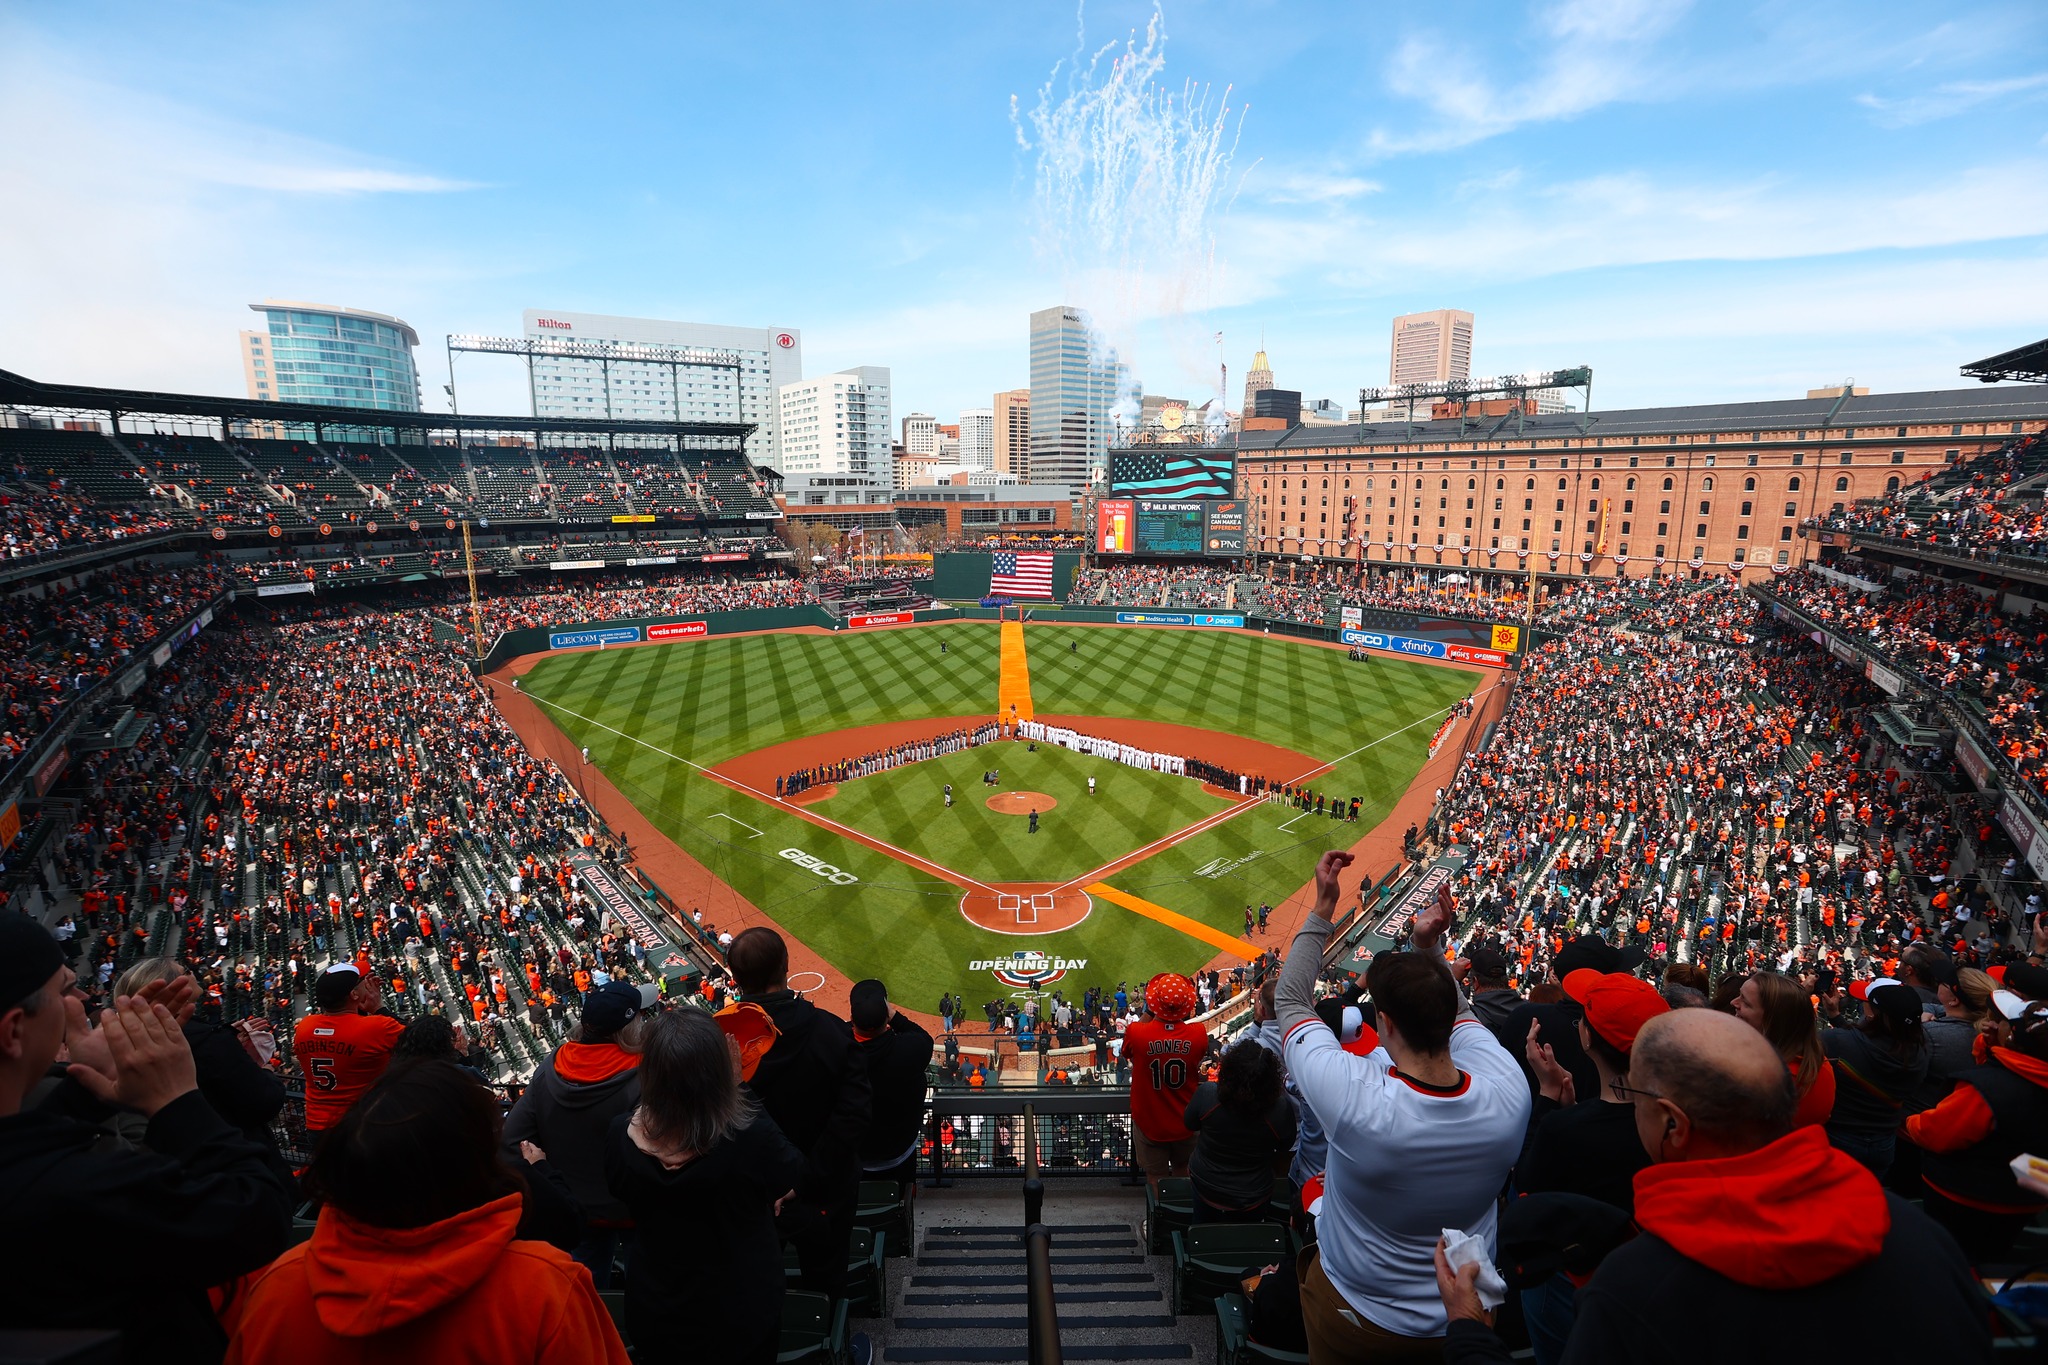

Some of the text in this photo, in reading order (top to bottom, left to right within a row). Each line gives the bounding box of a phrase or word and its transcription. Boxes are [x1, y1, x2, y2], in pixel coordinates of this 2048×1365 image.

[537, 319, 572, 330] Hilton
[1129, 433, 1153, 444] THE
[558, 516, 585, 524] GANZ
[215, 530, 225, 538] 20
[273, 527, 279, 535] 5
[1220, 541, 1241, 549] PNC
[1215, 617, 1234, 625] pepsi
[650, 625, 705, 636] weis markets
[1345, 632, 1383, 646] GEICO
[1401, 640, 1434, 654] xfinity
[2003, 797, 2030, 840] Point Breeze
[778, 848, 859, 885] GEICO
[1206, 850, 1265, 880] MedStar Health
[583, 866, 664, 948] WELCOME TO ORIOLE PARK
[1380, 867, 1449, 936] HOME OF THE ORIOLES
[969, 959, 1088, 971] OPENING DAY
[1147, 1039, 1192, 1055] JONES
[311, 1057, 337, 1090] 5
[1149, 1058, 1187, 1090] 10
